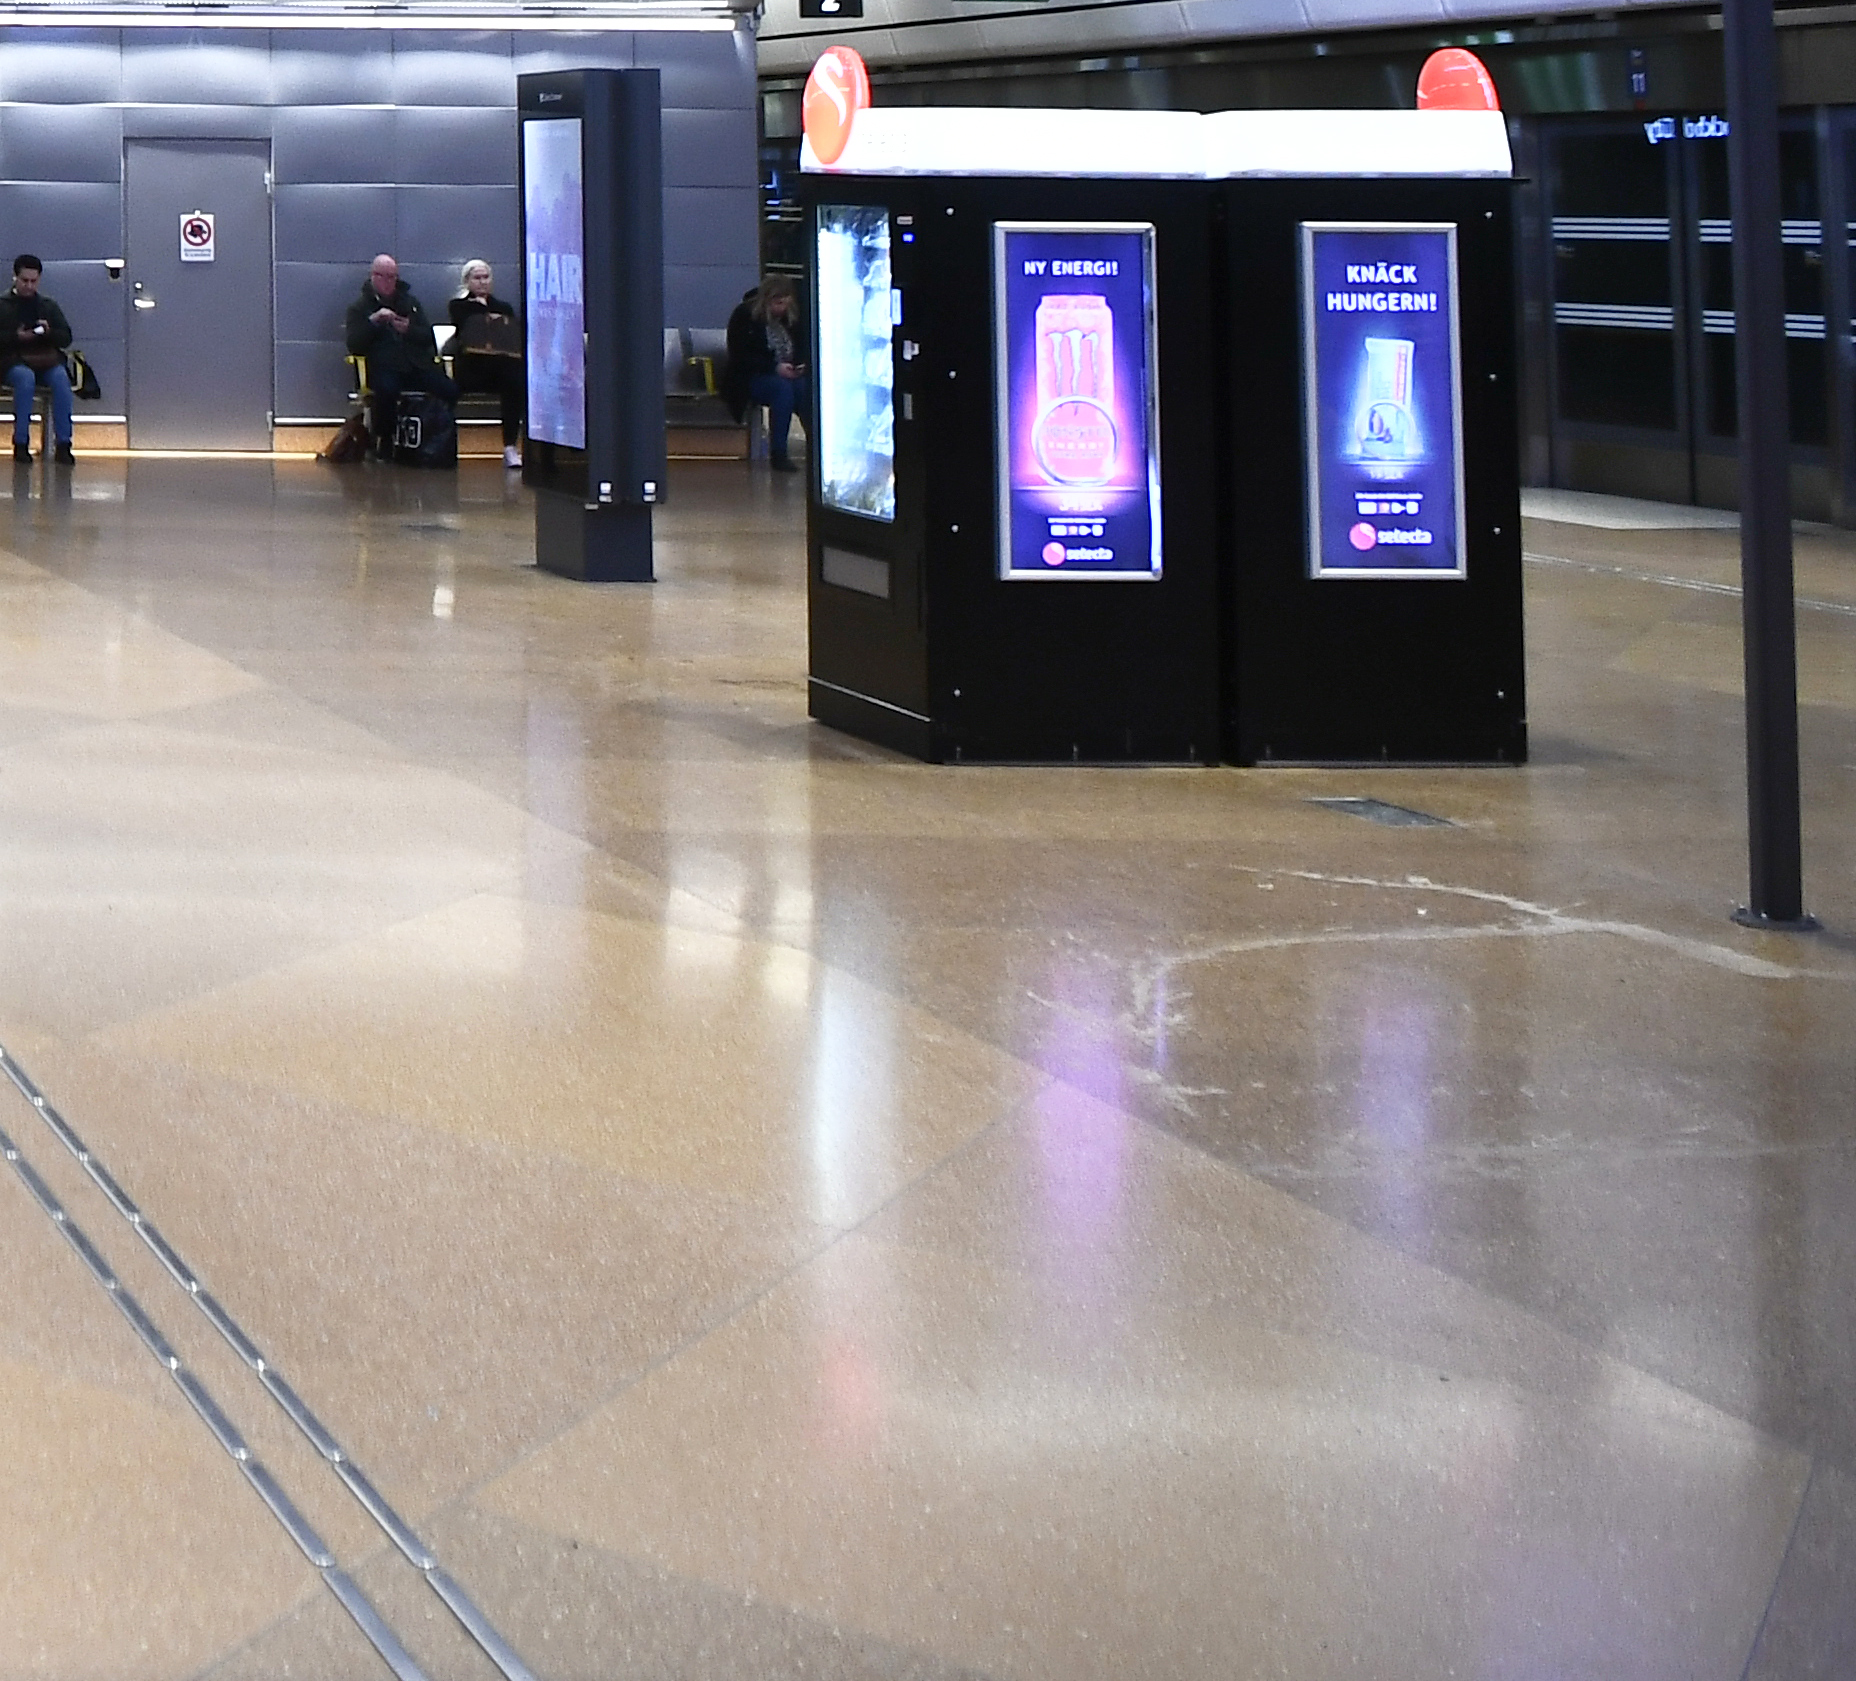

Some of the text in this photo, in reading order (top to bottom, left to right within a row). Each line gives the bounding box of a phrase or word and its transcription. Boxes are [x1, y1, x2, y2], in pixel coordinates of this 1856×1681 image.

[1024, 260, 1119, 276] NY ENERGI!
[1346, 261, 1418, 284] KNÄCK
[1326, 292, 1437, 312] HUNGERN!
